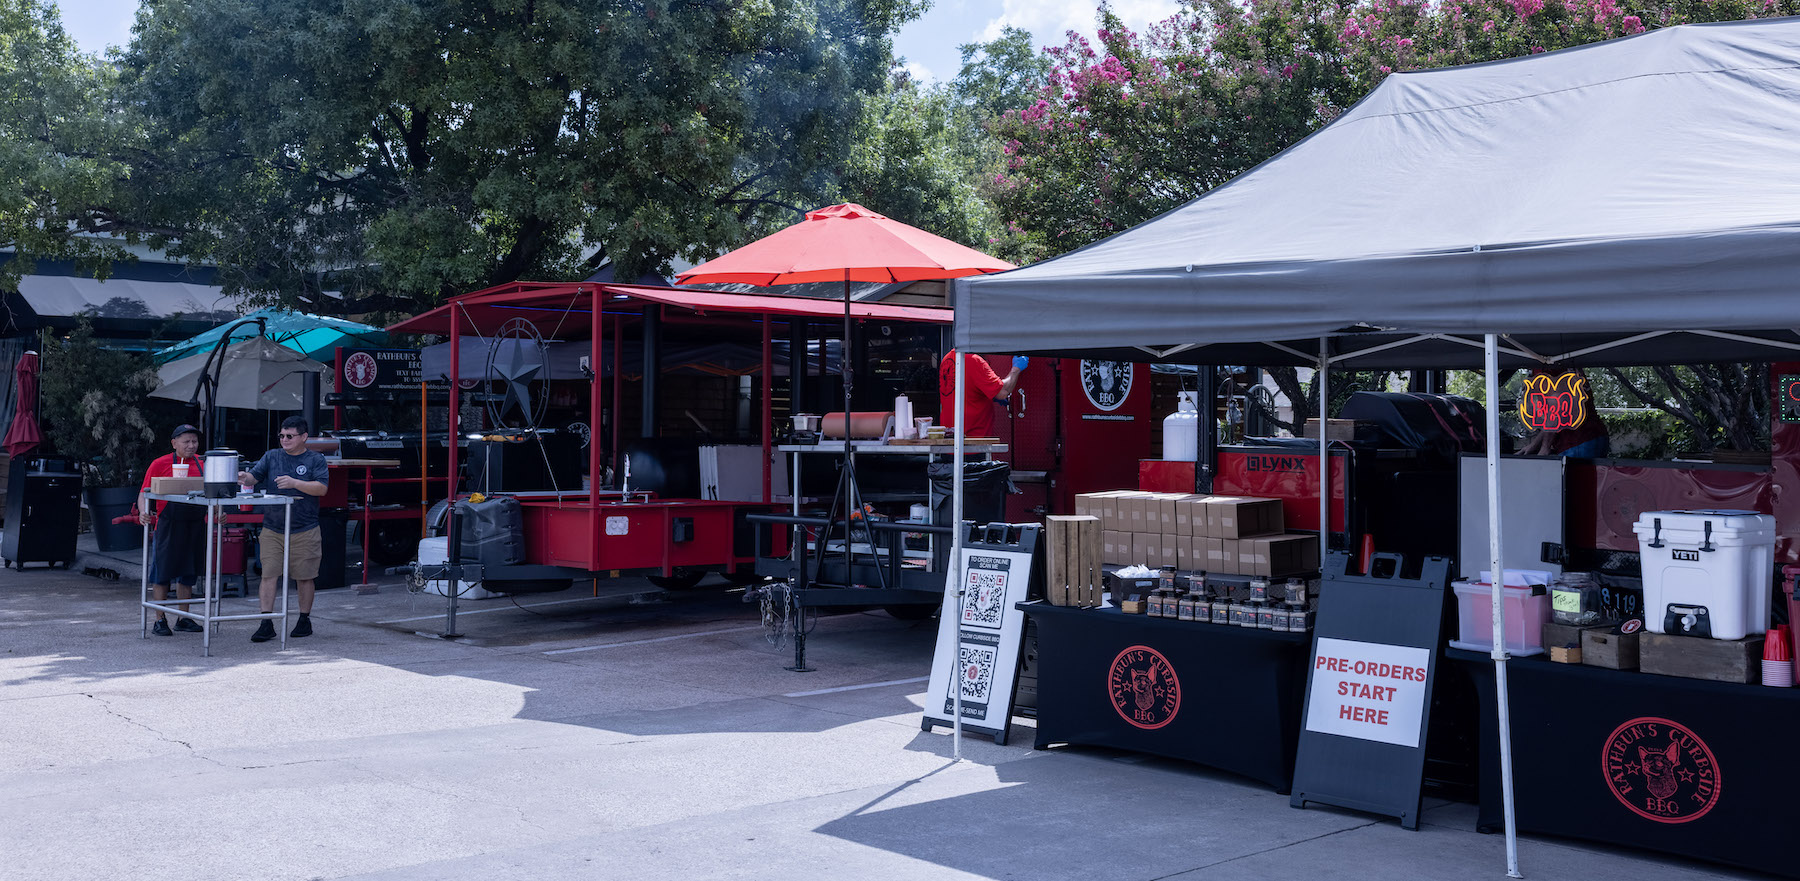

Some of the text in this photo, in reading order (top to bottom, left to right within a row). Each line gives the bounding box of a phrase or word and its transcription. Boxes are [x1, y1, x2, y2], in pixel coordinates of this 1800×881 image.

[377, 352, 416, 360] RATHBUN'S
[1099, 392, 1115, 403] BBQ
[1531, 392, 1573, 430] BBQ
[1262, 457, 1305, 471] LYNX
[1673, 550, 1698, 560] YETI
[1316, 656, 1426, 682] PRE-ORDERS
[1113, 651, 1176, 716] RATHBUN'S CURBSIDE
[1337, 681, 1397, 702] START
[960, 706, 977, 715] E-SEND
[1134, 710, 1155, 722] BBQ
[1339, 705, 1389, 726] HERE
[1610, 724, 1713, 807] RATHBUN'S CURBSIDE
[1646, 798, 1679, 814] BBQ
